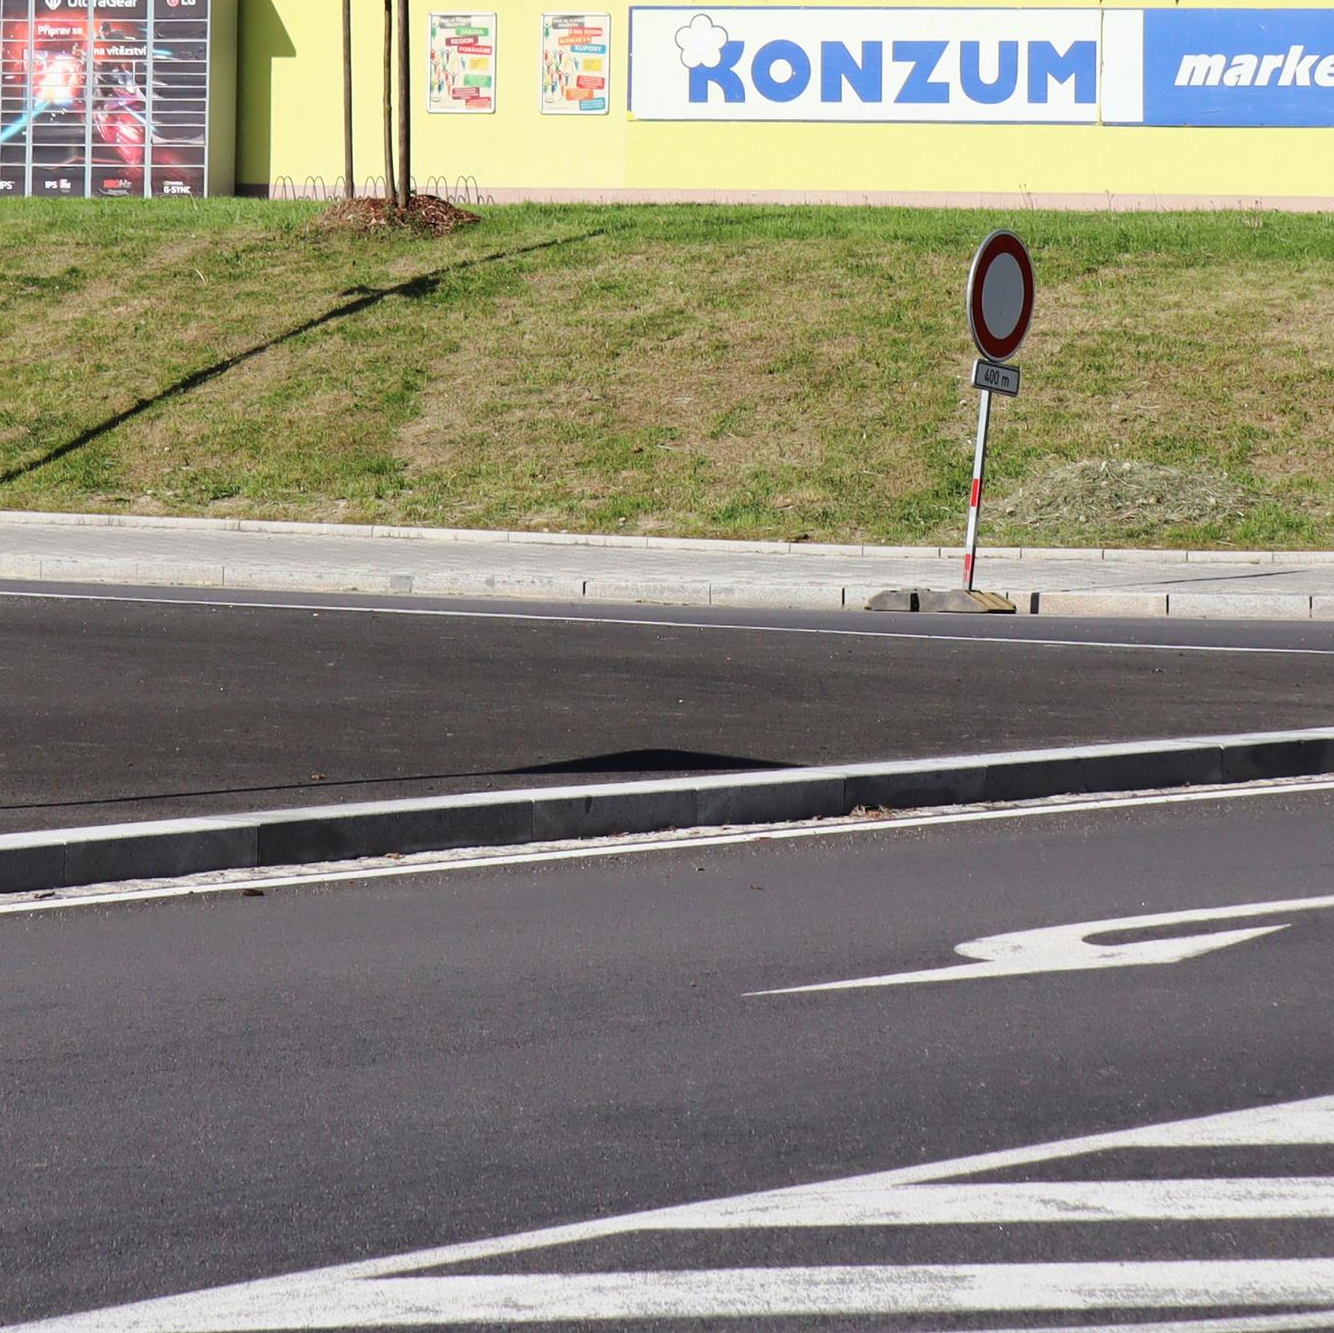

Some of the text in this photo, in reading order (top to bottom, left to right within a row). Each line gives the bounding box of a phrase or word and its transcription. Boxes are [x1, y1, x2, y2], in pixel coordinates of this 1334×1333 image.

[38, 25, 83, 36] Připrav se
[94, 46, 147, 56] na vítězství
[688, 38, 1097, 103] KONZUM
[984, 368, 1009, 387] 400 m
